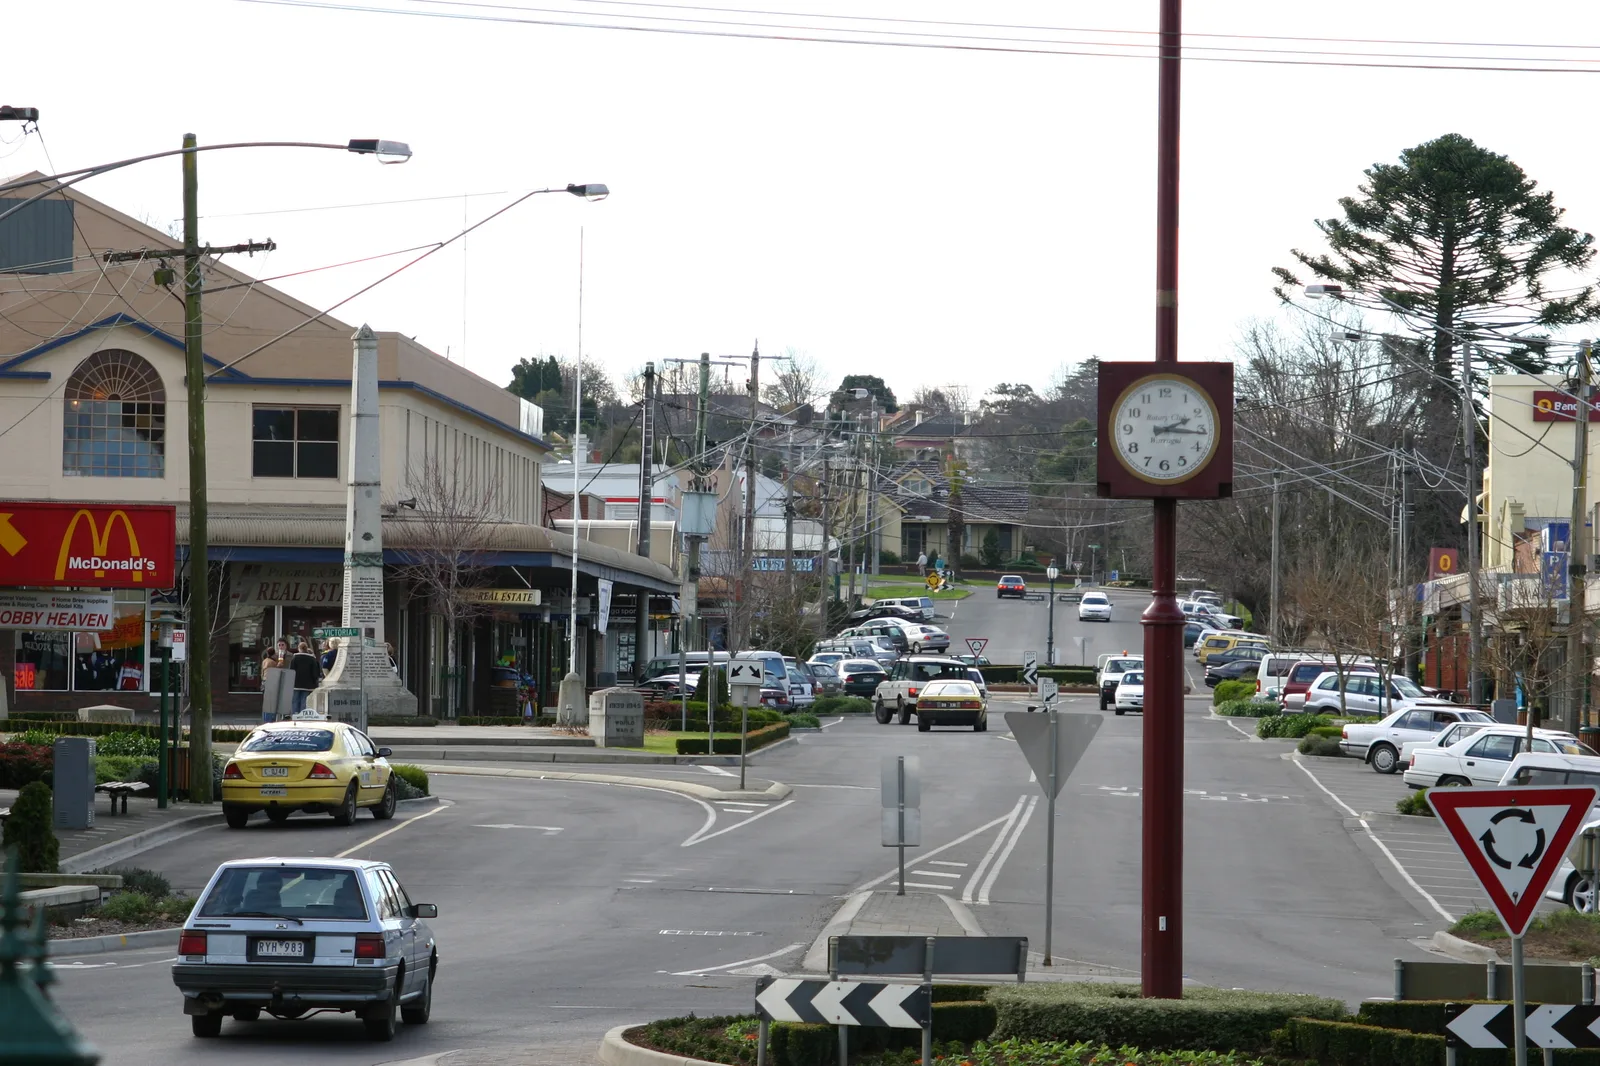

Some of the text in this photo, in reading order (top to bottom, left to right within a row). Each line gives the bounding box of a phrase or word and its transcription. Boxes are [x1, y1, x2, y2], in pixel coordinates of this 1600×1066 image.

[1159, 388, 1172, 398] 12
[1141, 394, 1151, 404] 11
[1183, 394, 1187, 403] 1
[1129, 408, 1141, 418] 10
[1193, 408, 1202, 418] 2
[1123, 424, 1134, 435] 9
[1197, 424, 1206, 434] 3
[1129, 442, 1138, 453] 8
[1191, 442, 1201, 452] 4
[1144, 457, 1152, 467] 7
[1159, 460, 1170, 471] 6
[1178, 456, 1187, 466] 5
[69, 557, 155, 570] McDonald's
[257, 582, 301, 601] REAL
[478, 592, 533, 602] REAL ESTATE
[0, 610, 108, 627] OBBY HEAVEN
[259, 942, 302, 952] RYH 983
